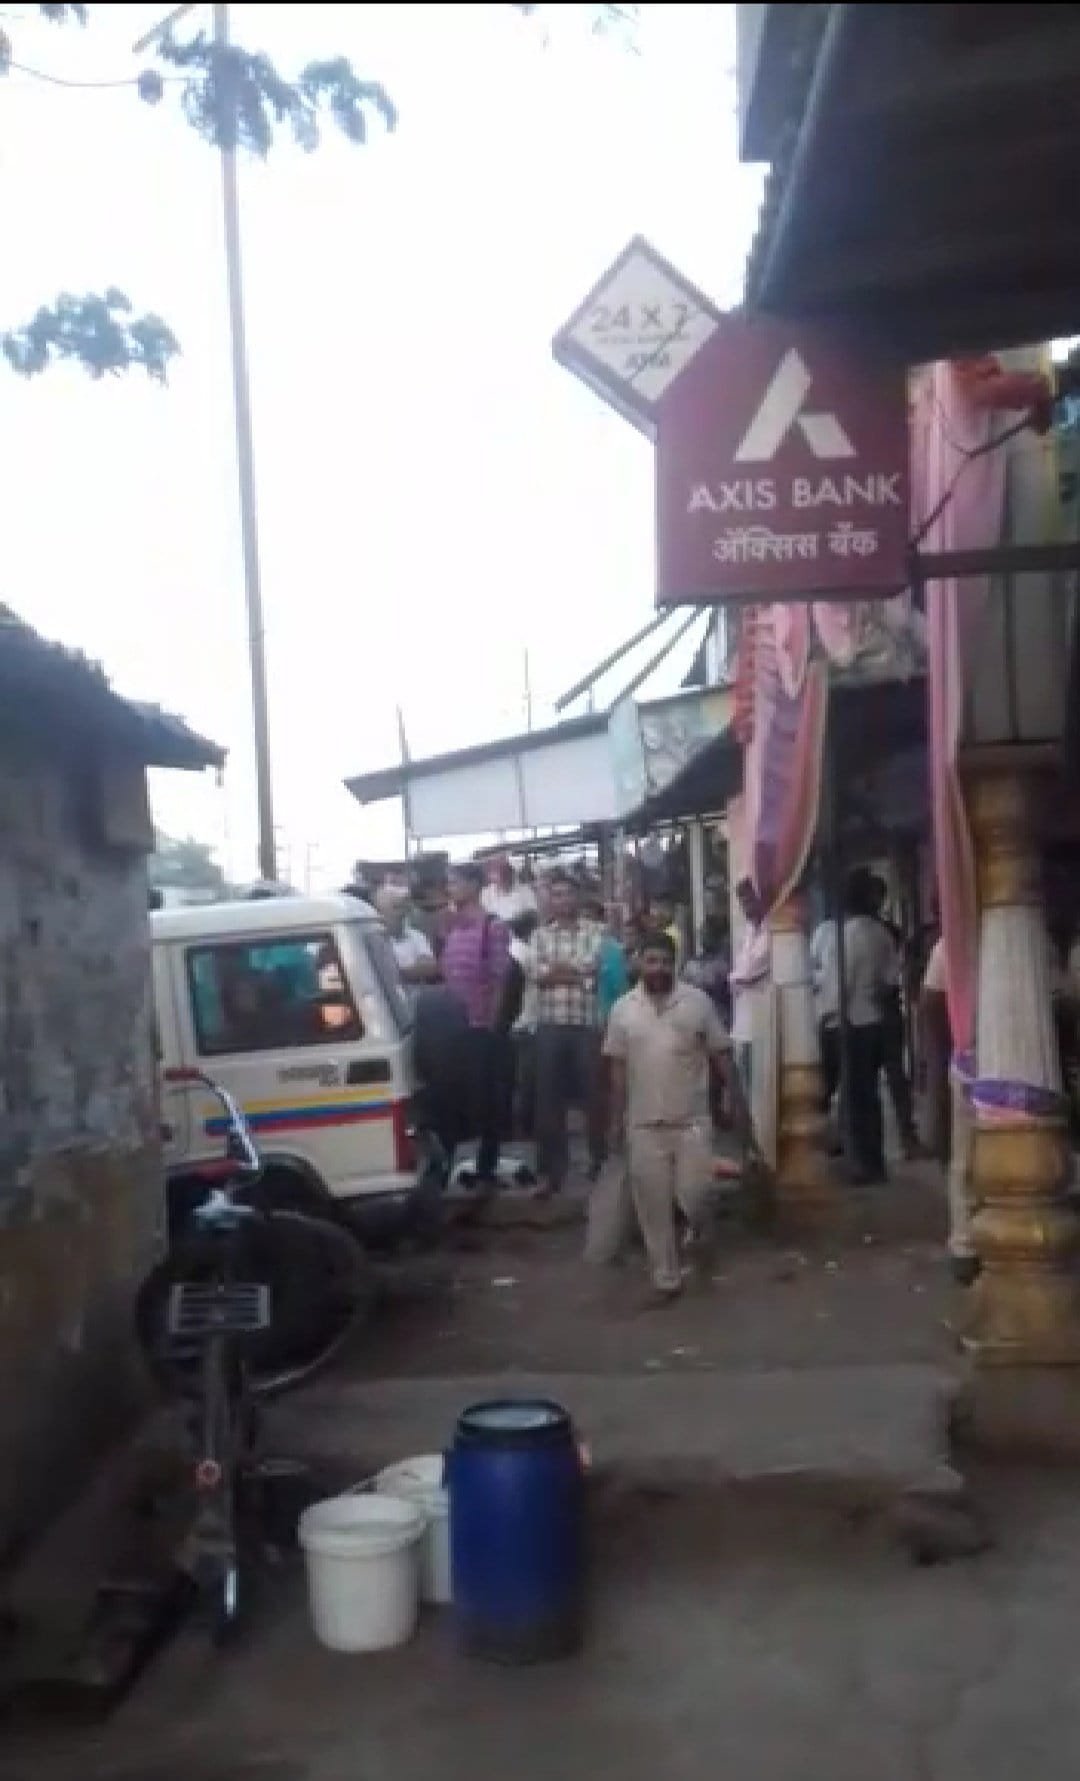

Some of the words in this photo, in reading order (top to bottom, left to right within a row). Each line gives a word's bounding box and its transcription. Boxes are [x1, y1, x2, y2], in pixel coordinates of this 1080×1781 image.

[591, 304, 630, 332] 24
[672, 303, 688, 332] 7
[687, 478, 777, 513] AXIS
[792, 472, 903, 508] BANK
